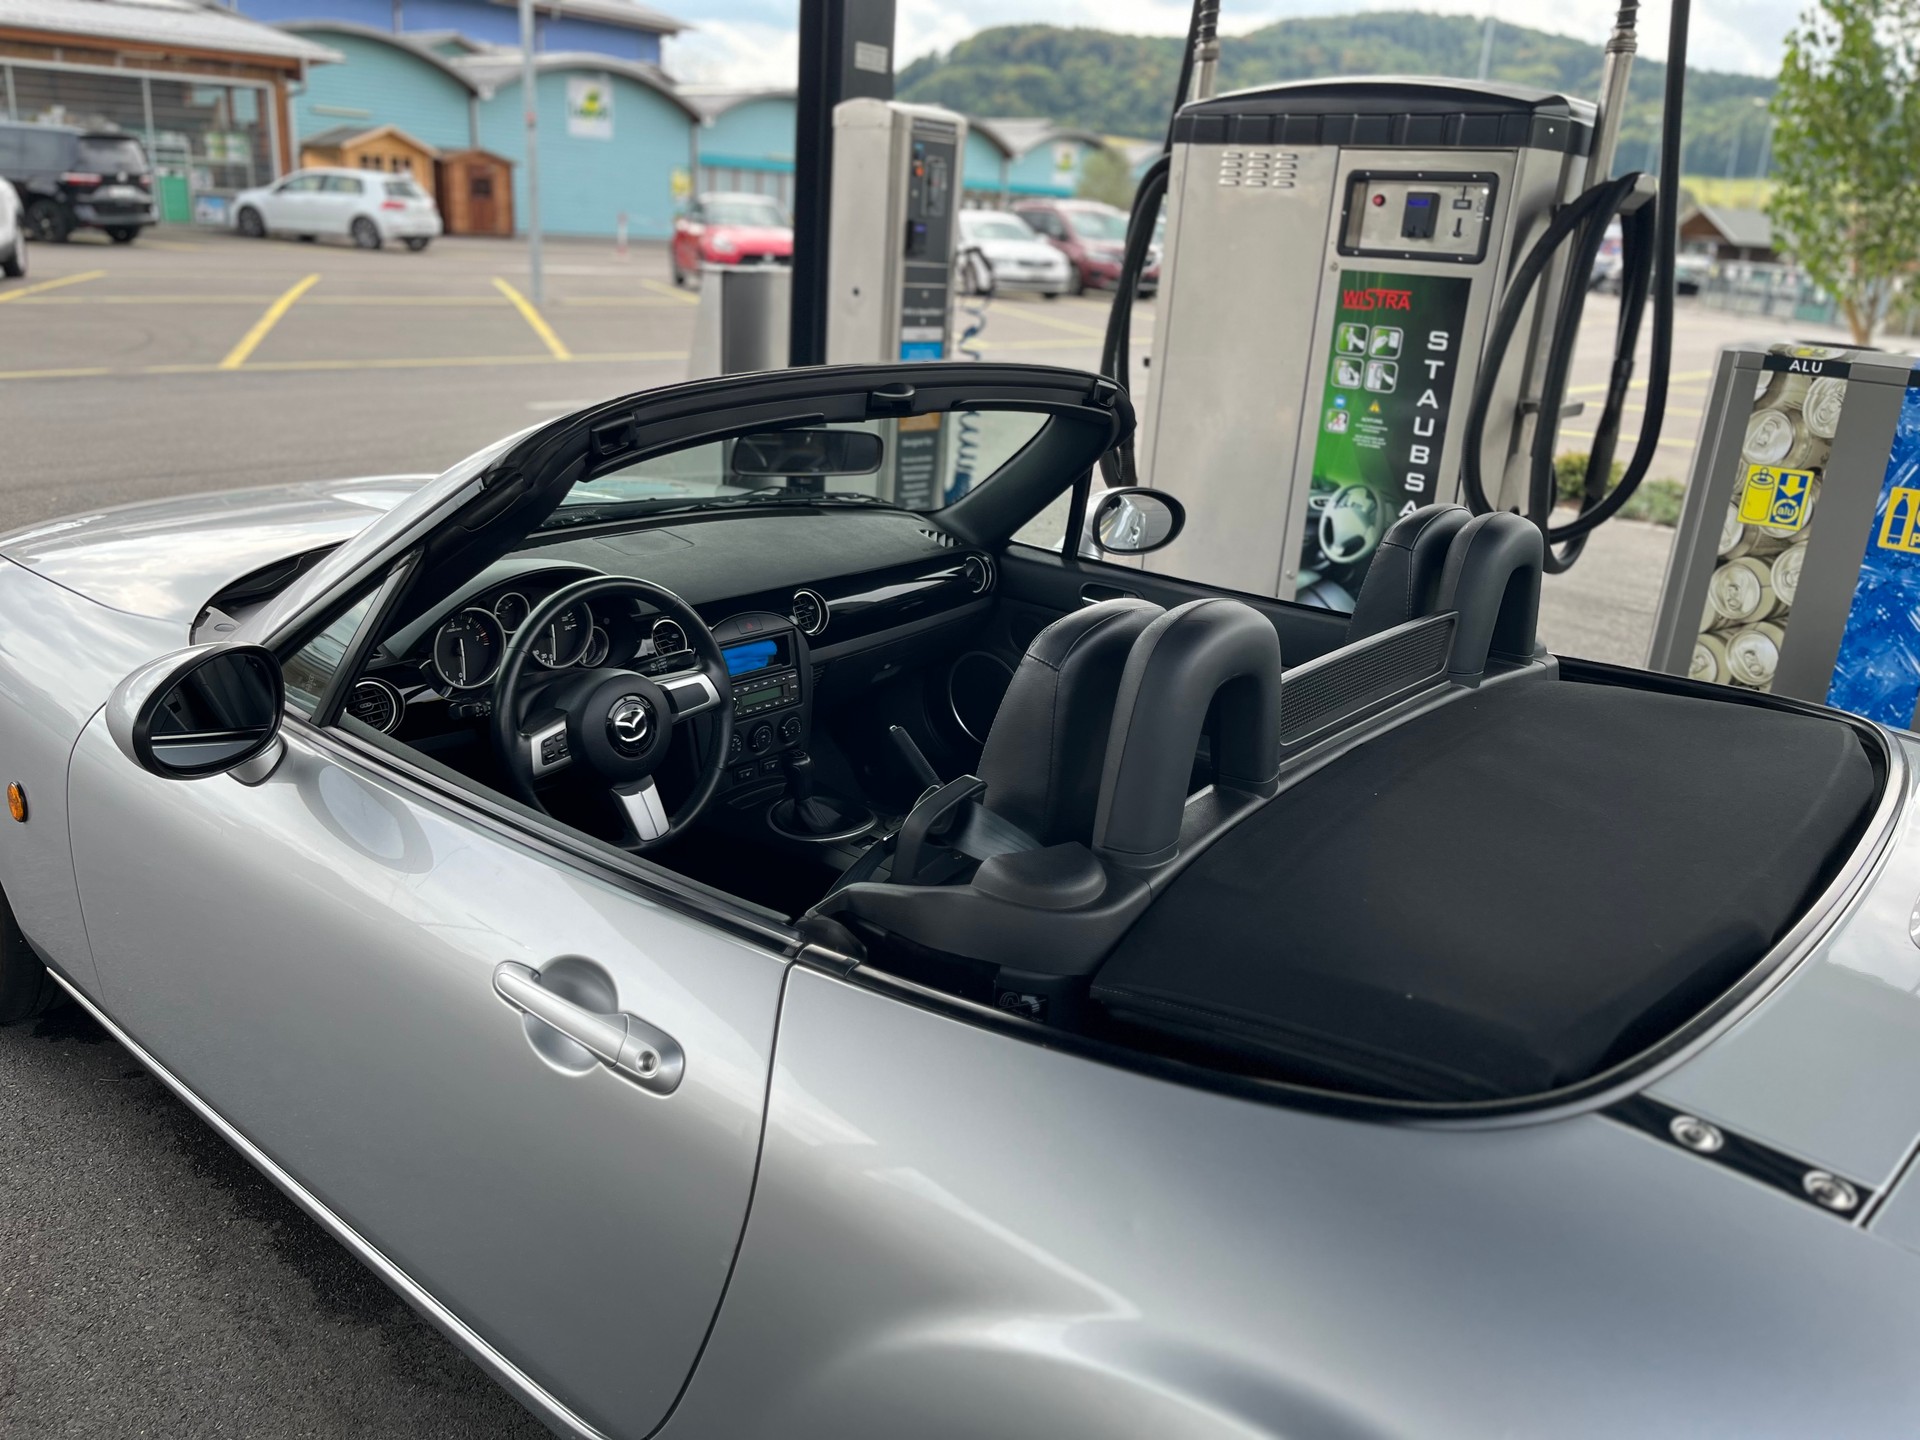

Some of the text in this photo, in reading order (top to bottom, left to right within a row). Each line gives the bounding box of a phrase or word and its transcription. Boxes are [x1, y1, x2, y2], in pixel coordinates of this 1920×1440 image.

[1343, 288, 1412, 311] WISTRA
[1789, 359, 1823, 374] ALU
[1777, 505, 1794, 516] alu
